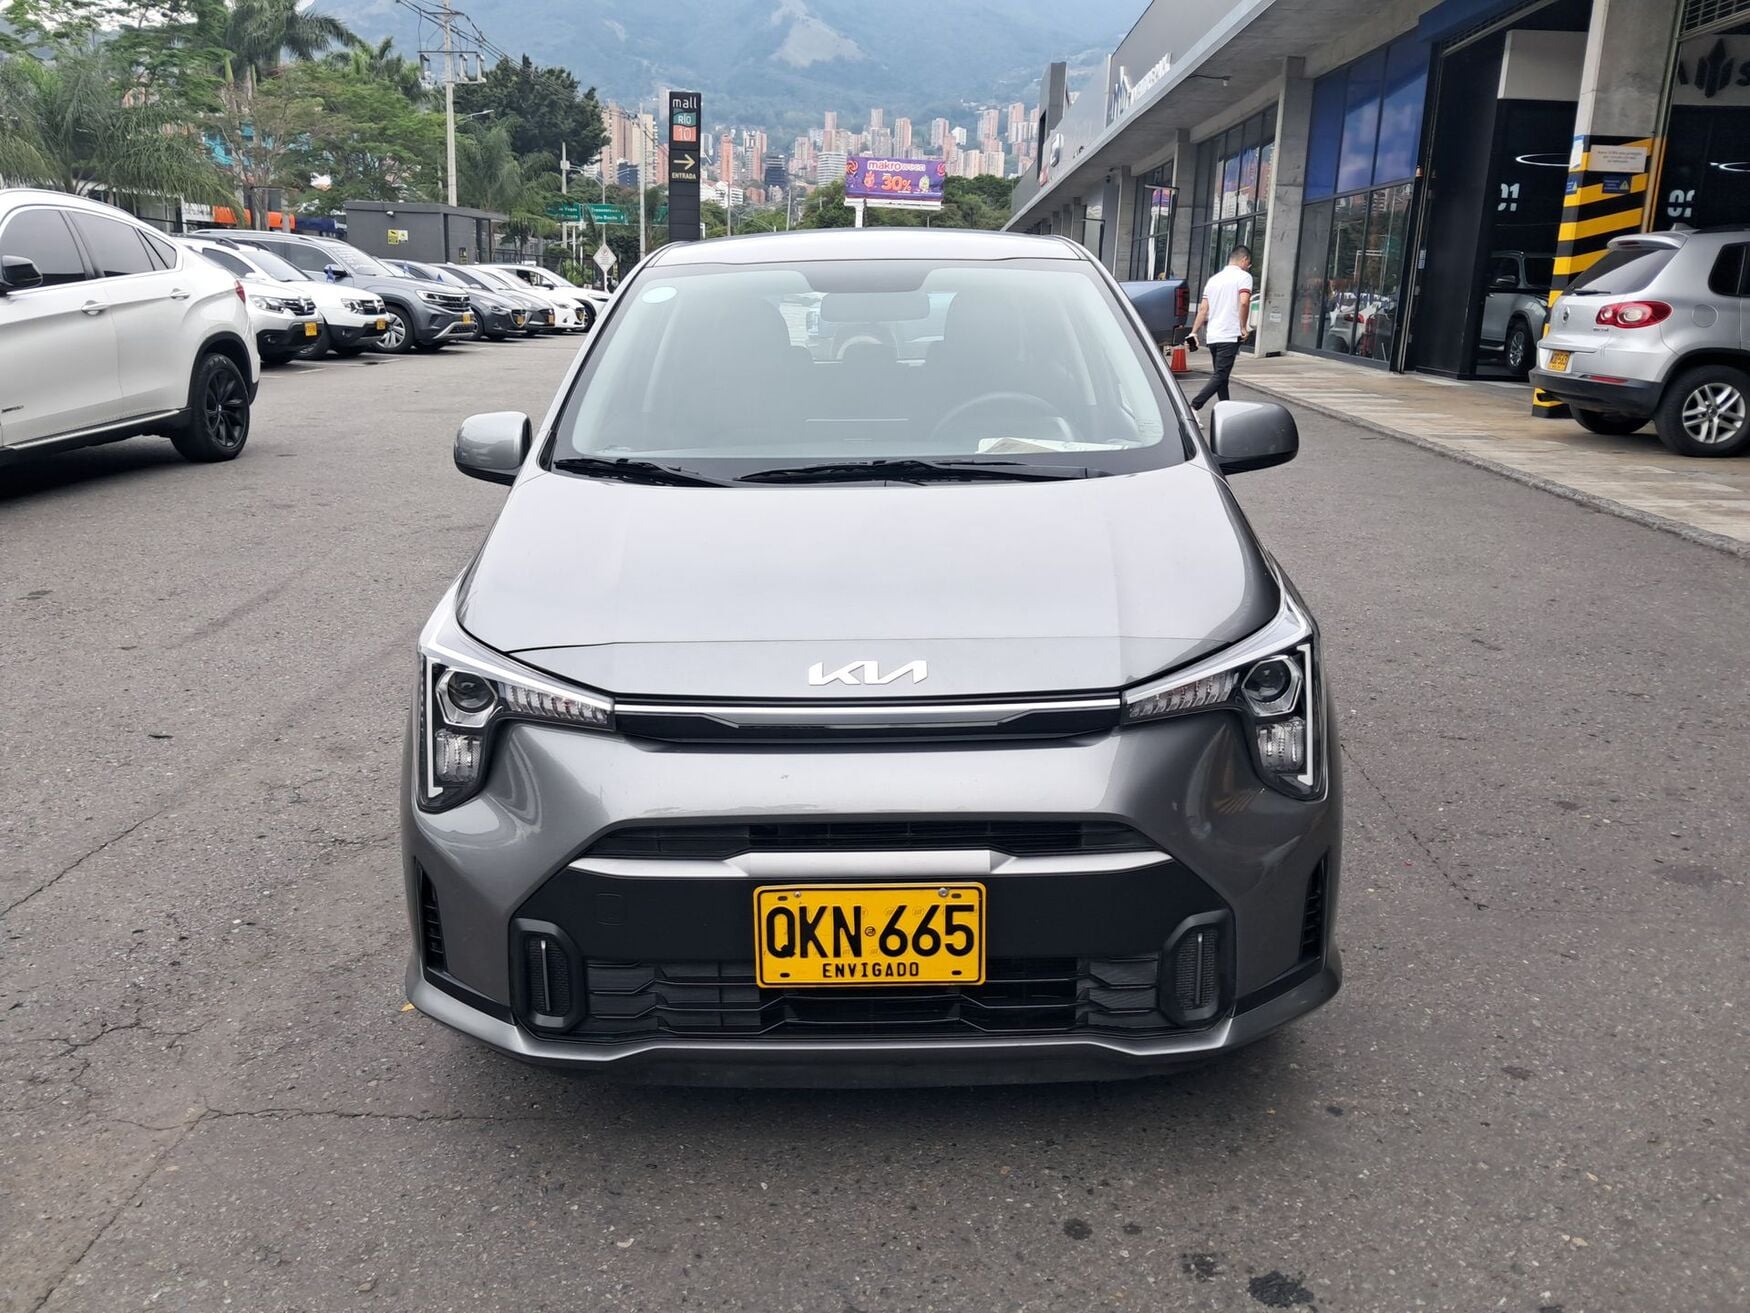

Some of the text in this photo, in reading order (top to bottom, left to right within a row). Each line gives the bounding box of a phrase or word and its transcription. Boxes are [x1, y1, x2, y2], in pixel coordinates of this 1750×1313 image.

[672, 96, 697, 109] mall
[678, 128, 692, 140] 10
[671, 172, 697, 180] ENTRADA
[881, 175, 912, 191] 30%
[808, 660, 928, 686] KIA
[766, 904, 975, 958] QKN 665
[822, 962, 919, 978] ENVIGADO
